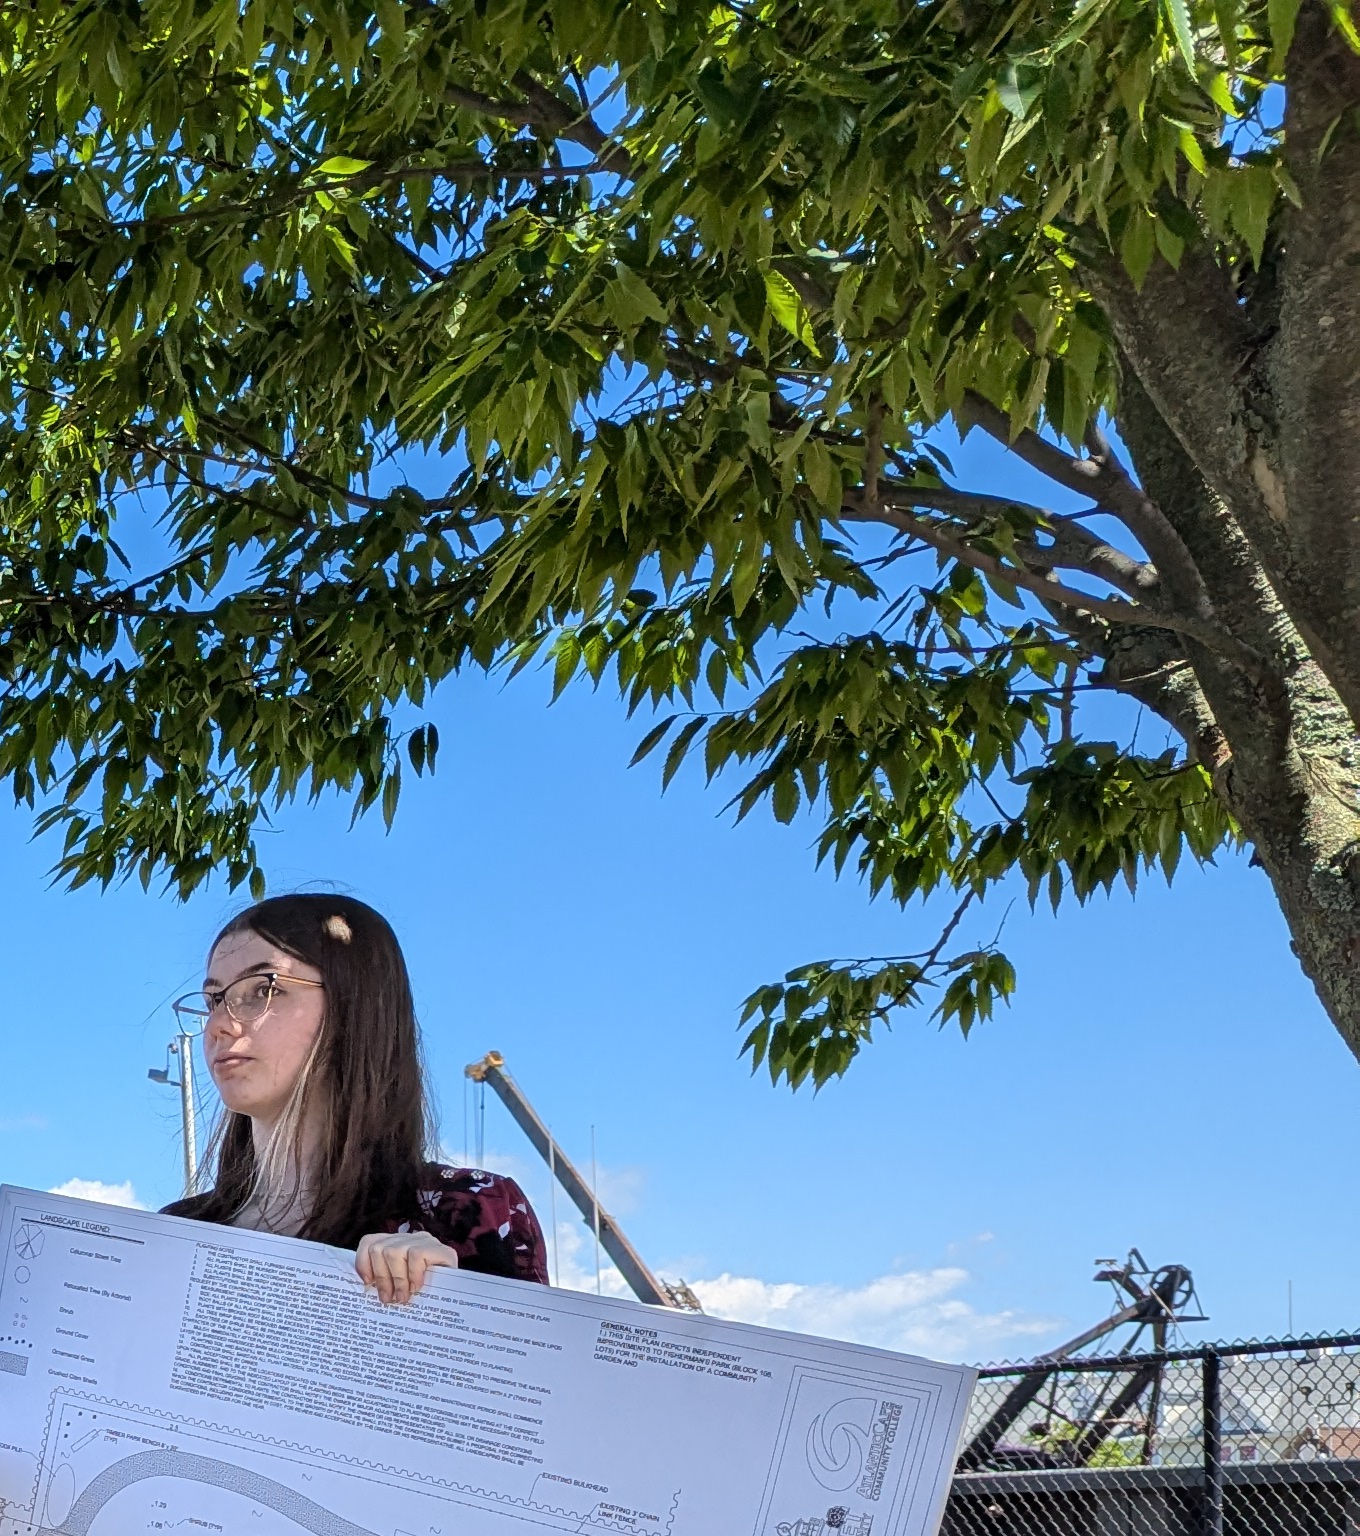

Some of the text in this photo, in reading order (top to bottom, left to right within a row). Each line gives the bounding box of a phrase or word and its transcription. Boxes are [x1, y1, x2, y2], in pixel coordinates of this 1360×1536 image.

[39, 1213, 81, 1228] LANDSCAPE
[62, 1281, 88, 1293] Relocated
[58, 1305, 75, 1315] Shrub
[54, 1326, 89, 1340] Ground Cover
[599, 1320, 658, 1338] GENERAL NOTES
[51, 1347, 95, 1364] Ornamental Grass
[592, 1352, 623, 1364] GARDEN
[596, 1336, 651, 1354] IMPROVEMENTS
[710, 1359, 731, 1370] PARK
[730, 1363, 758, 1375] (BLOCK
[640, 1337, 660, 1347] PLAN
[660, 1341, 691, 1353] DEPICTS
[691, 1347, 742, 1363] INDEPENDENT
[47, 1367, 69, 1379] Crushed
[81, 1376, 98, 1386] Shells
[645, 1354, 695, 1371] INSTALLATION
[713, 1368, 757, 1383] COMMUNITY
[870, 1404, 904, 1502] COMMUNITY COLLEGE
[541, 1471, 609, 1494] EXISTING BULKHEAD
[599, 1501, 631, 1516] EXISTING
[638, 1511, 660, 1523] CHAIN
[613, 1513, 637, 1525] FENCE
